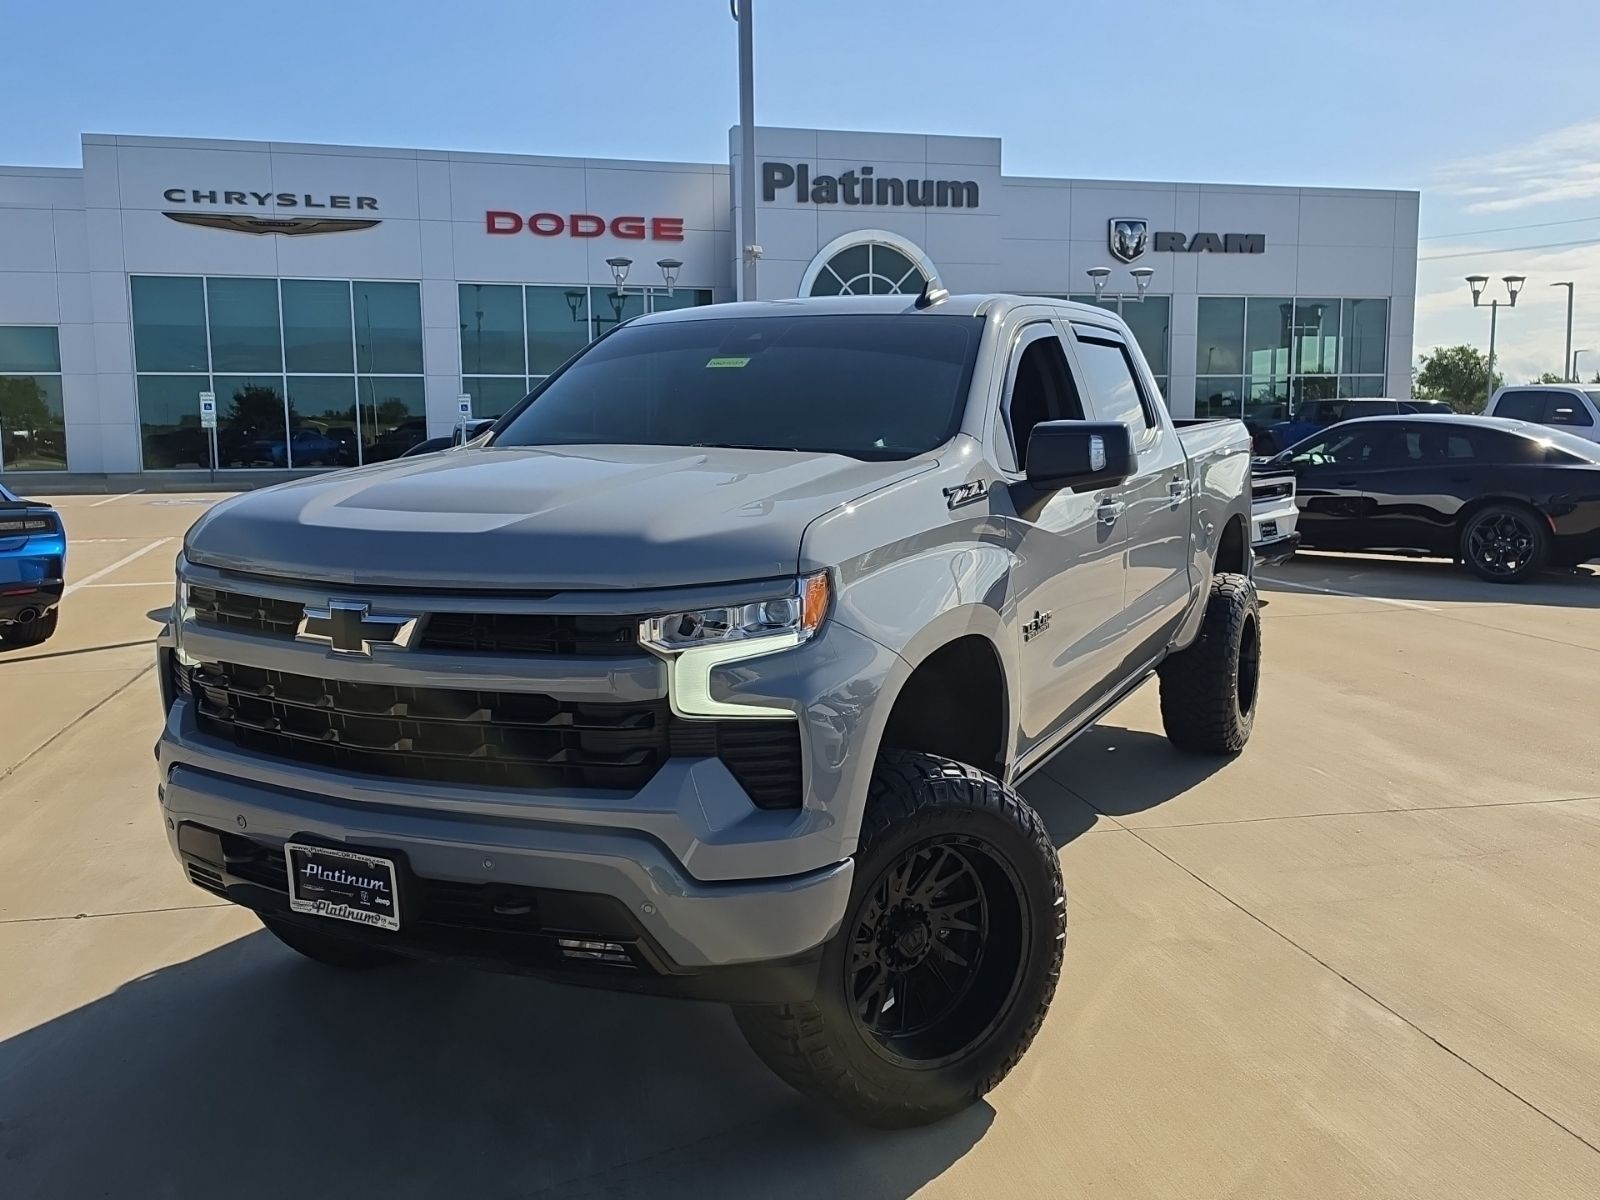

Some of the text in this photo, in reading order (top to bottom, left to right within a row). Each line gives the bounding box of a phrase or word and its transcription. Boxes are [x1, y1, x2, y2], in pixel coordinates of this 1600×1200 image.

[762, 161, 980, 208] Platinum
[163, 188, 379, 211] CHRYSLER
[486, 211, 684, 241] DODGE
[1154, 231, 1266, 254] RAM
[300, 863, 390, 892] Platinum
[312, 900, 381, 925] Platinum
[374, 896, 391, 907] Jeep
